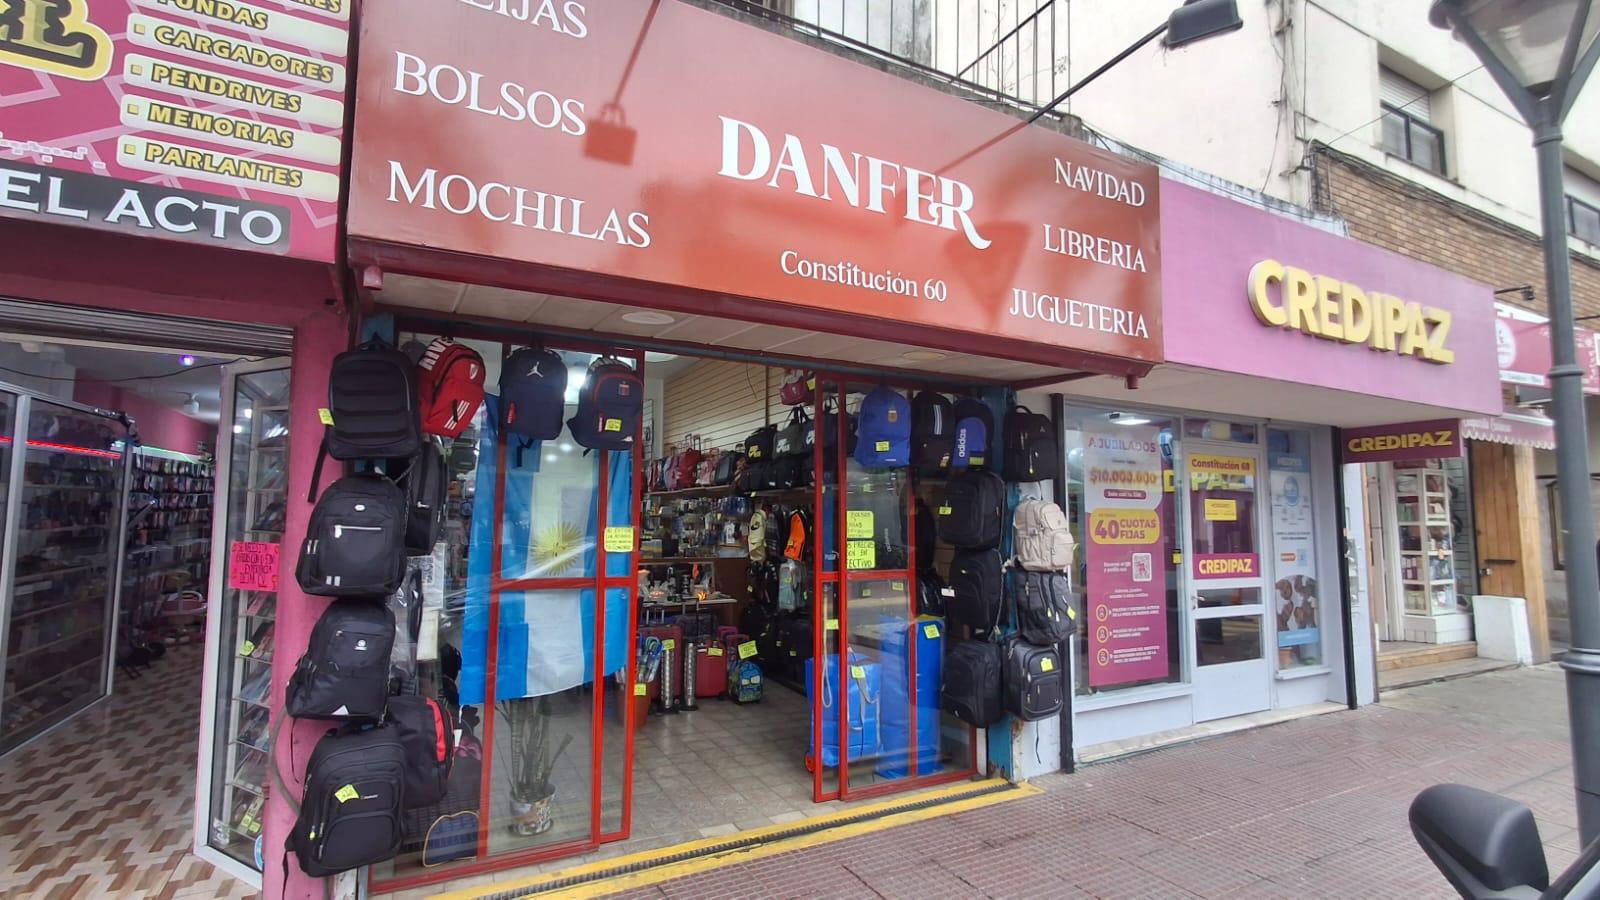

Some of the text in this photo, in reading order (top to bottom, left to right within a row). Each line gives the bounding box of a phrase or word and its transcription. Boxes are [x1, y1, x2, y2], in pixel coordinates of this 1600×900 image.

[154, 25, 334, 83] CARGADORES
[151, 63, 302, 113] PENDRIVES
[393, 50, 587, 137] BOLSOS
[148, 103, 294, 149] MEMORIAS
[145, 143, 303, 188] PARLANTES
[718, 115, 992, 250] DANFER
[1054, 157, 1146, 208] NAVIDAD
[0, 168, 283, 246] EL ACTO
[386, 160, 651, 248] MOCHILAS
[1043, 223, 1147, 273] LIBRERIA
[780, 250, 947, 303] Constitución 60
[1009, 288, 1150, 339] JUGUETERIA
[1248, 258, 1455, 365] CREDIPAZ
[957, 428, 967, 457] adidas
[1348, 430, 1453, 452] CREDIPAZ
[1094, 518, 1156, 539] 40 CUOTAS
[1120, 530, 1146, 540] FIJAS
[1199, 558, 1253, 574] CREDIPAZ
